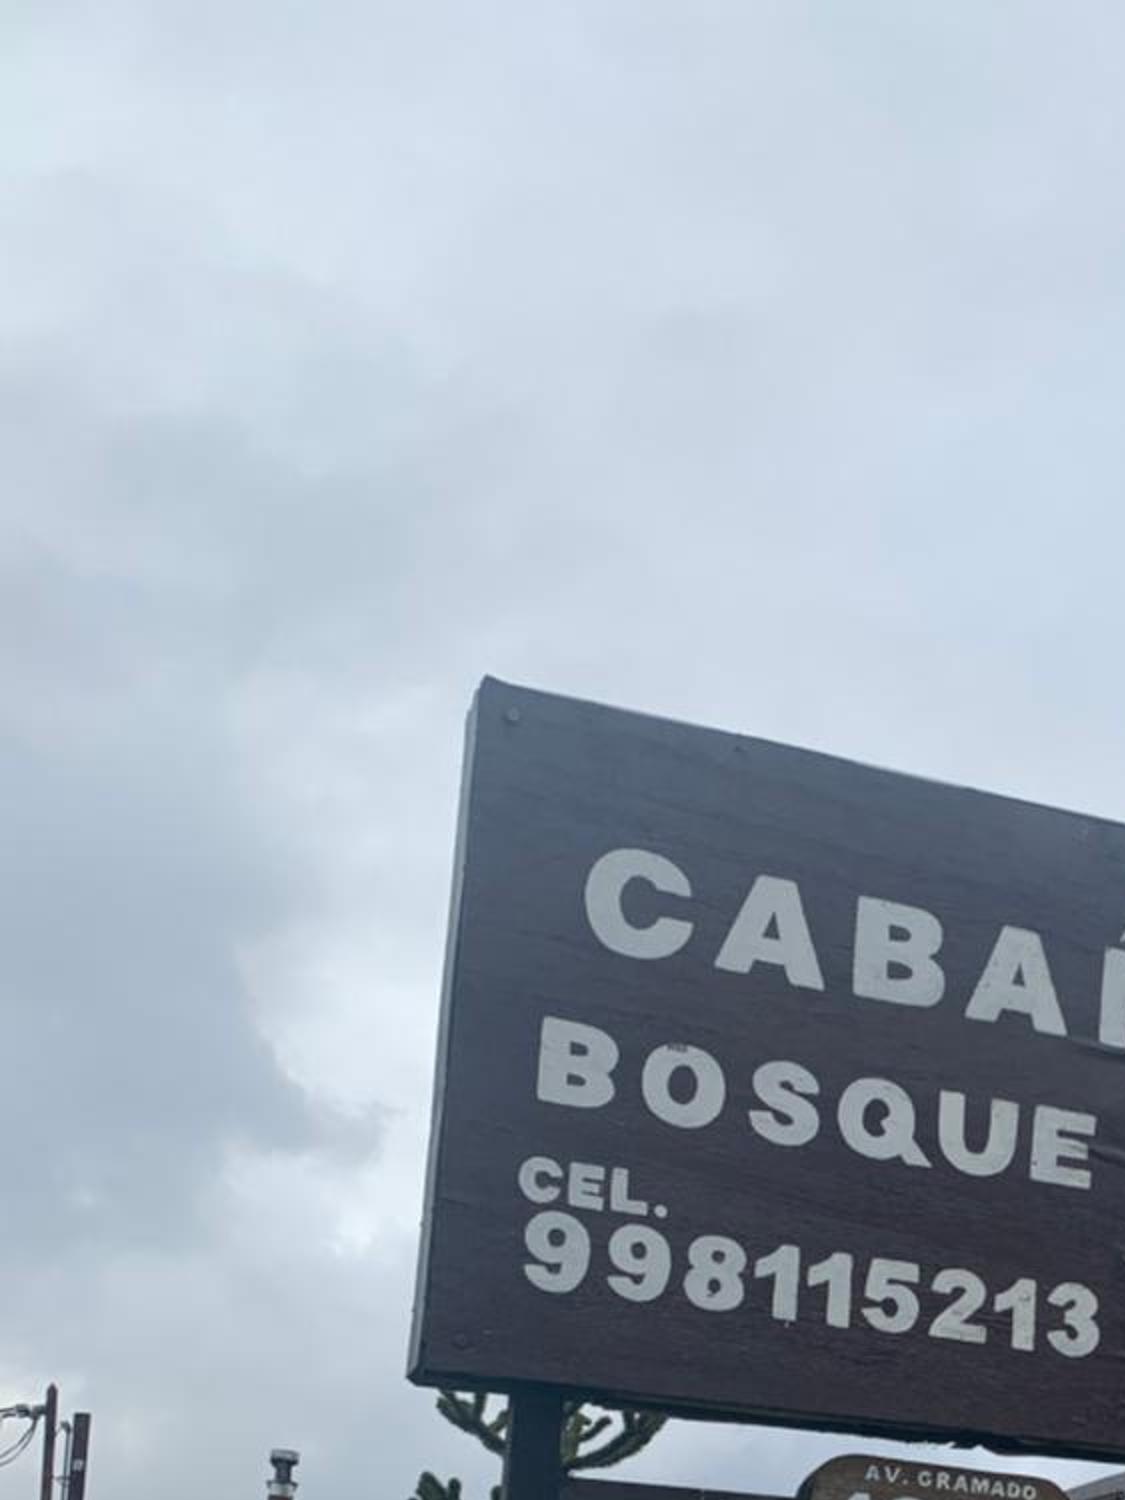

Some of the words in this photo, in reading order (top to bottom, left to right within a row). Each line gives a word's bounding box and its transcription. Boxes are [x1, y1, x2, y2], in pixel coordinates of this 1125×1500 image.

[536, 1016, 1097, 1189] BOSQUE
[518, 1156, 668, 1218] CEL.
[524, 1210, 1100, 1357] 998115213
[864, 1465, 909, 1485] AV.
[917, 1471, 1037, 1500] GRAMADO
